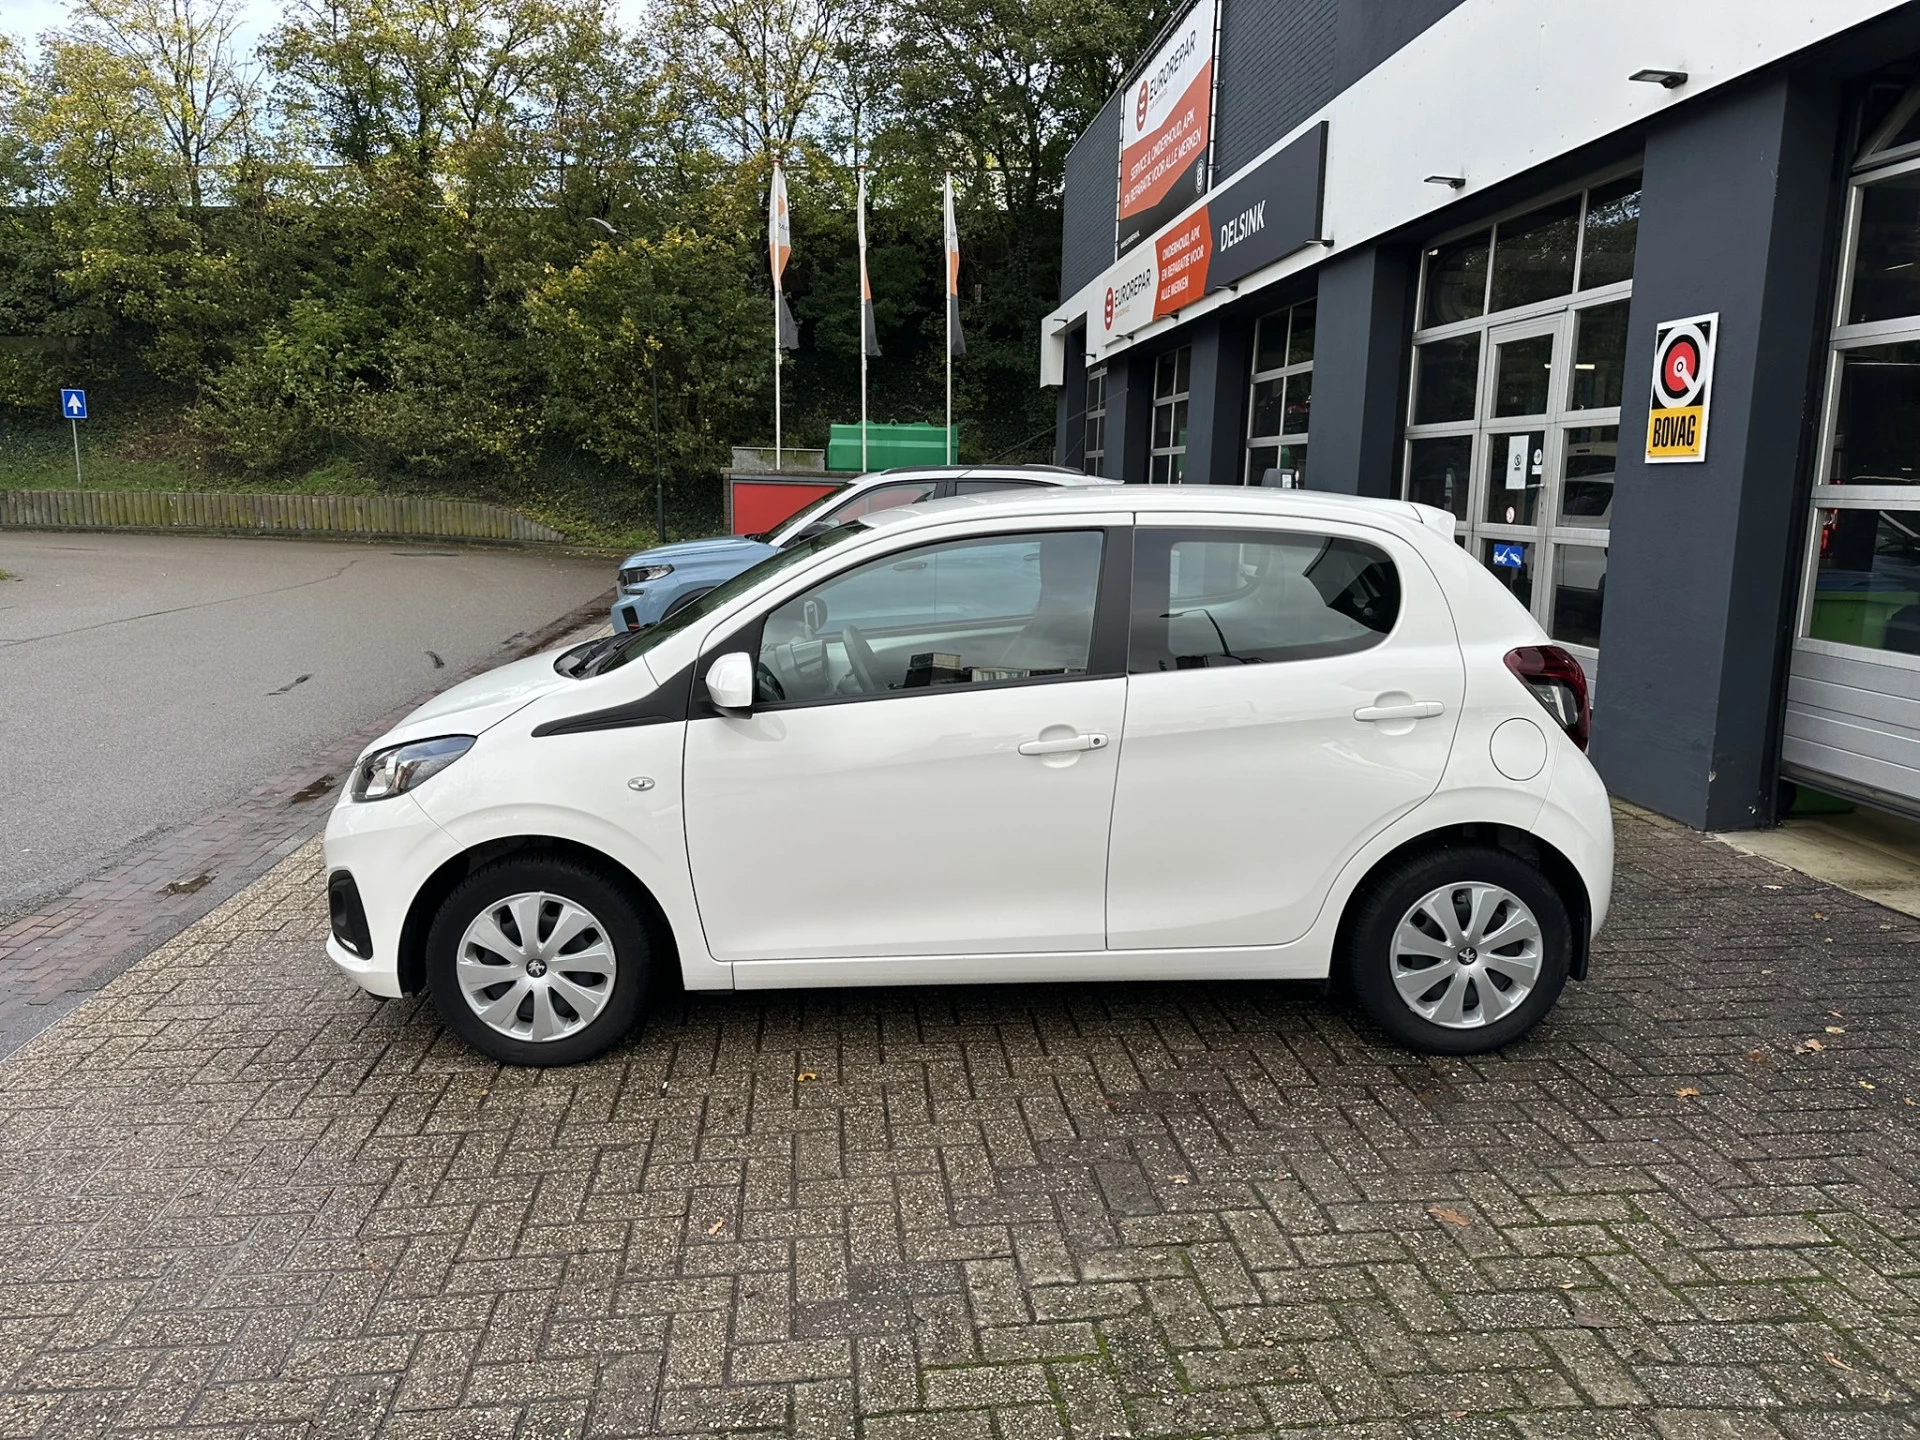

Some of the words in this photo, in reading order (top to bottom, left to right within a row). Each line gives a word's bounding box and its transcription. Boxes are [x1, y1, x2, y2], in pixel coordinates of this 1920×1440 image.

[1149, 29, 1196, 101] EUROREPAR
[1182, 107, 1196, 129] APK
[1165, 150, 1178, 172] ALLE
[1220, 200, 1266, 252] DELSINK
[1114, 268, 1151, 307] EUROREPAR
[1652, 414, 1697, 448] BOVAG
